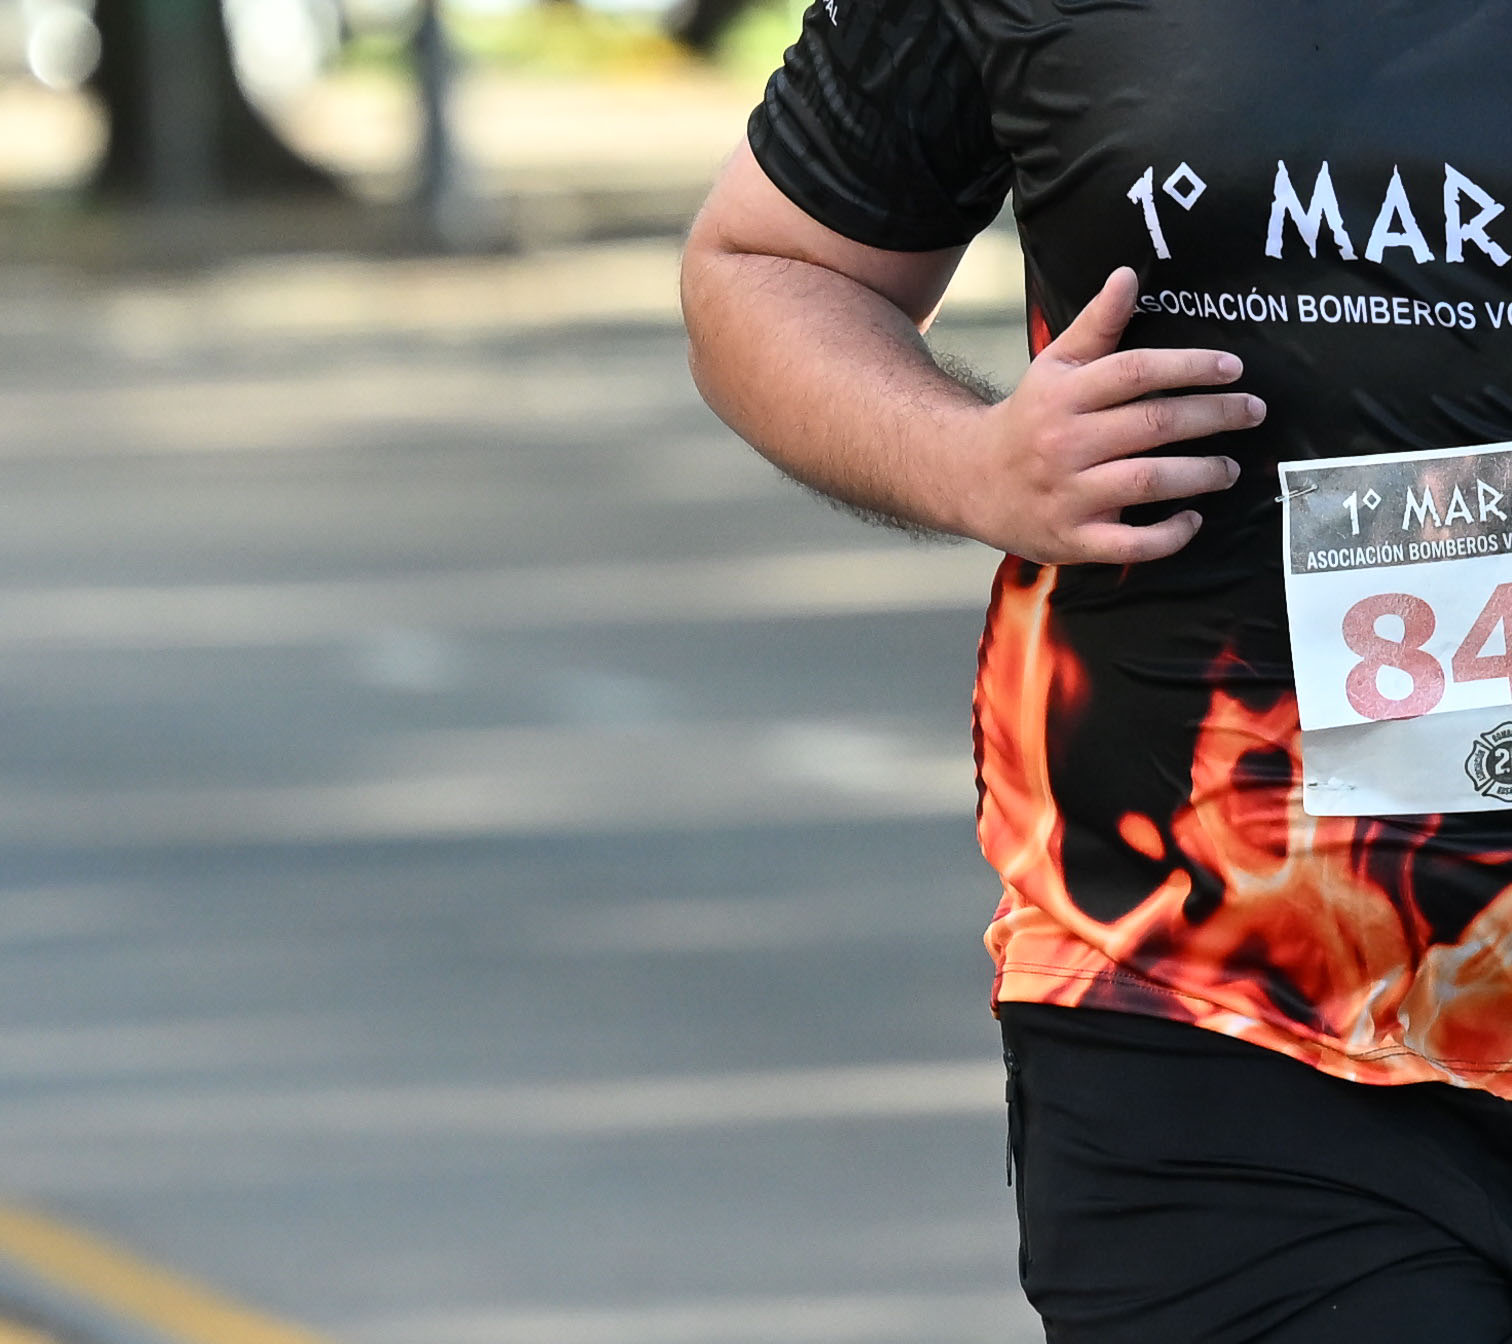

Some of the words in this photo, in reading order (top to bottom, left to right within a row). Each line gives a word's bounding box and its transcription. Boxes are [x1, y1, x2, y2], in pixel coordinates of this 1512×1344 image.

[1297, 294, 1476, 329] BOMBEROS
[1306, 540, 1405, 570] ASOCIACIÓN
[1408, 533, 1498, 561] BOMBEROS
